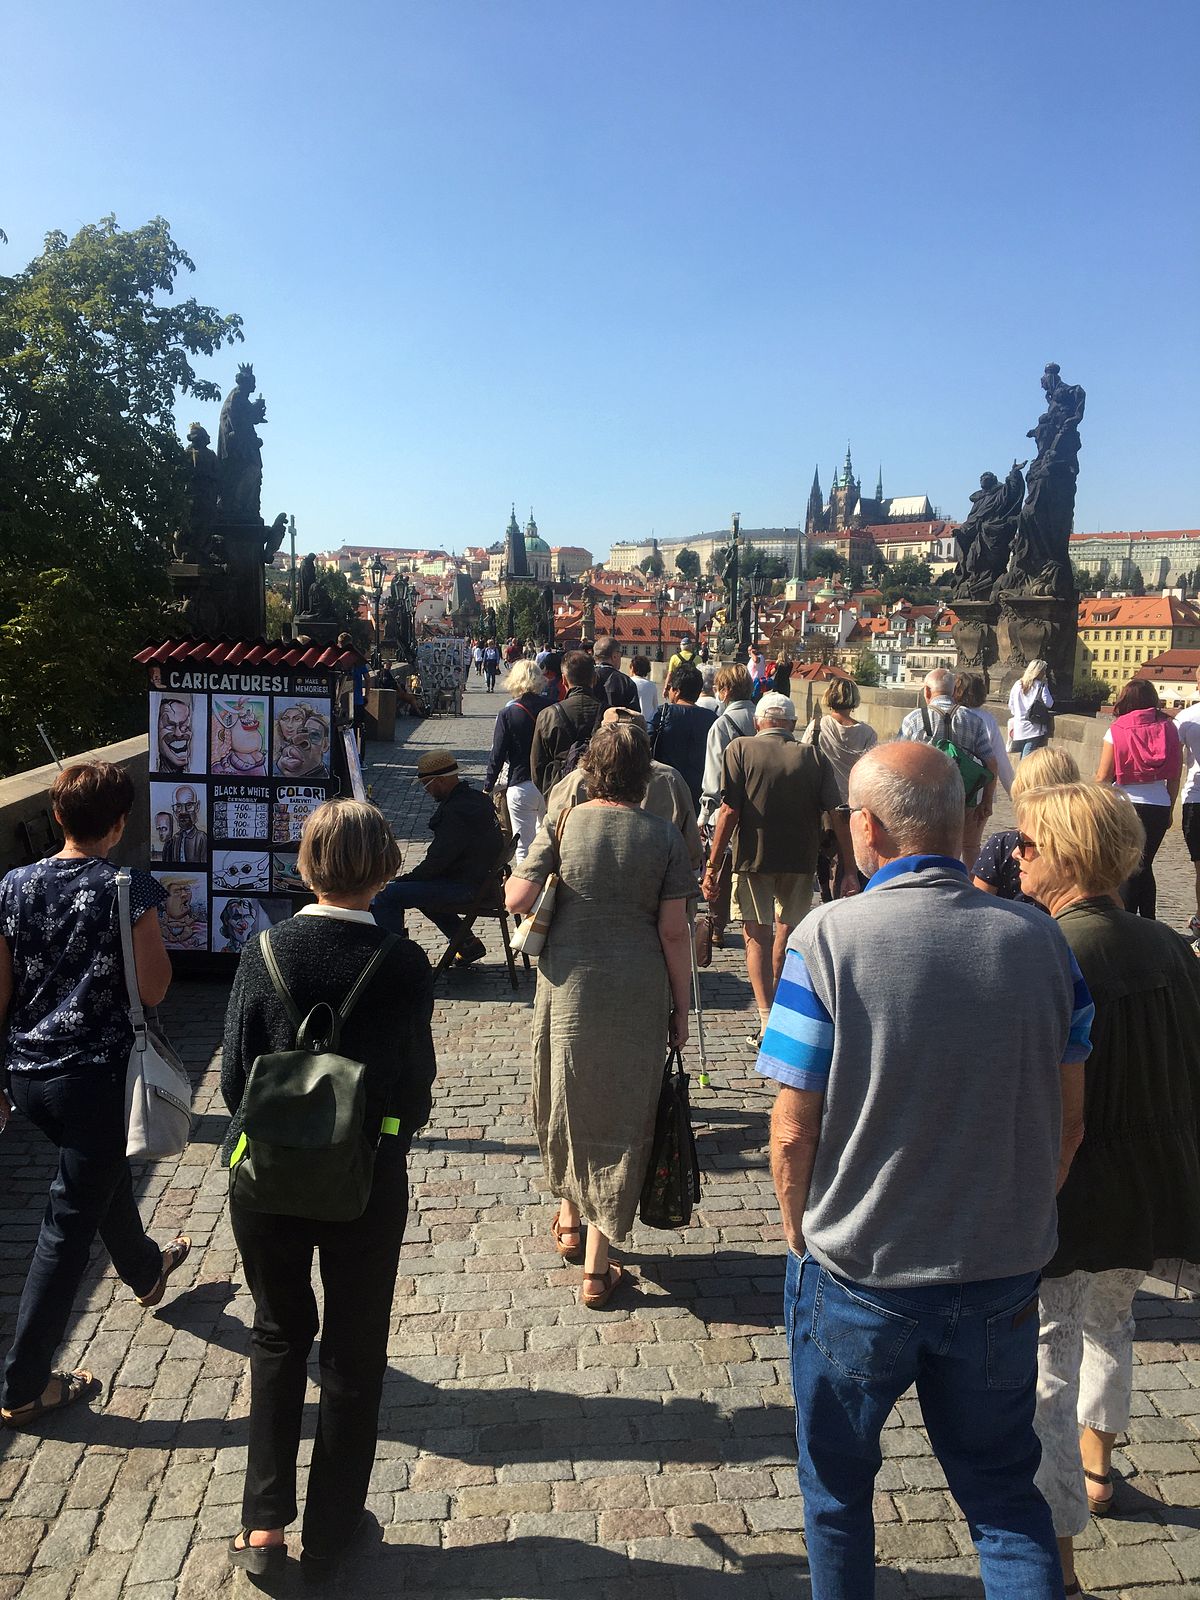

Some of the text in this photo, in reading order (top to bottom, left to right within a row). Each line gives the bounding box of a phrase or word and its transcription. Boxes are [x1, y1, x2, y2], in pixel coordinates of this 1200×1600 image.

[214, 785, 238, 797] BLACK
[240, 785, 246, 796] &
[278, 787, 325, 801] COLOR!
